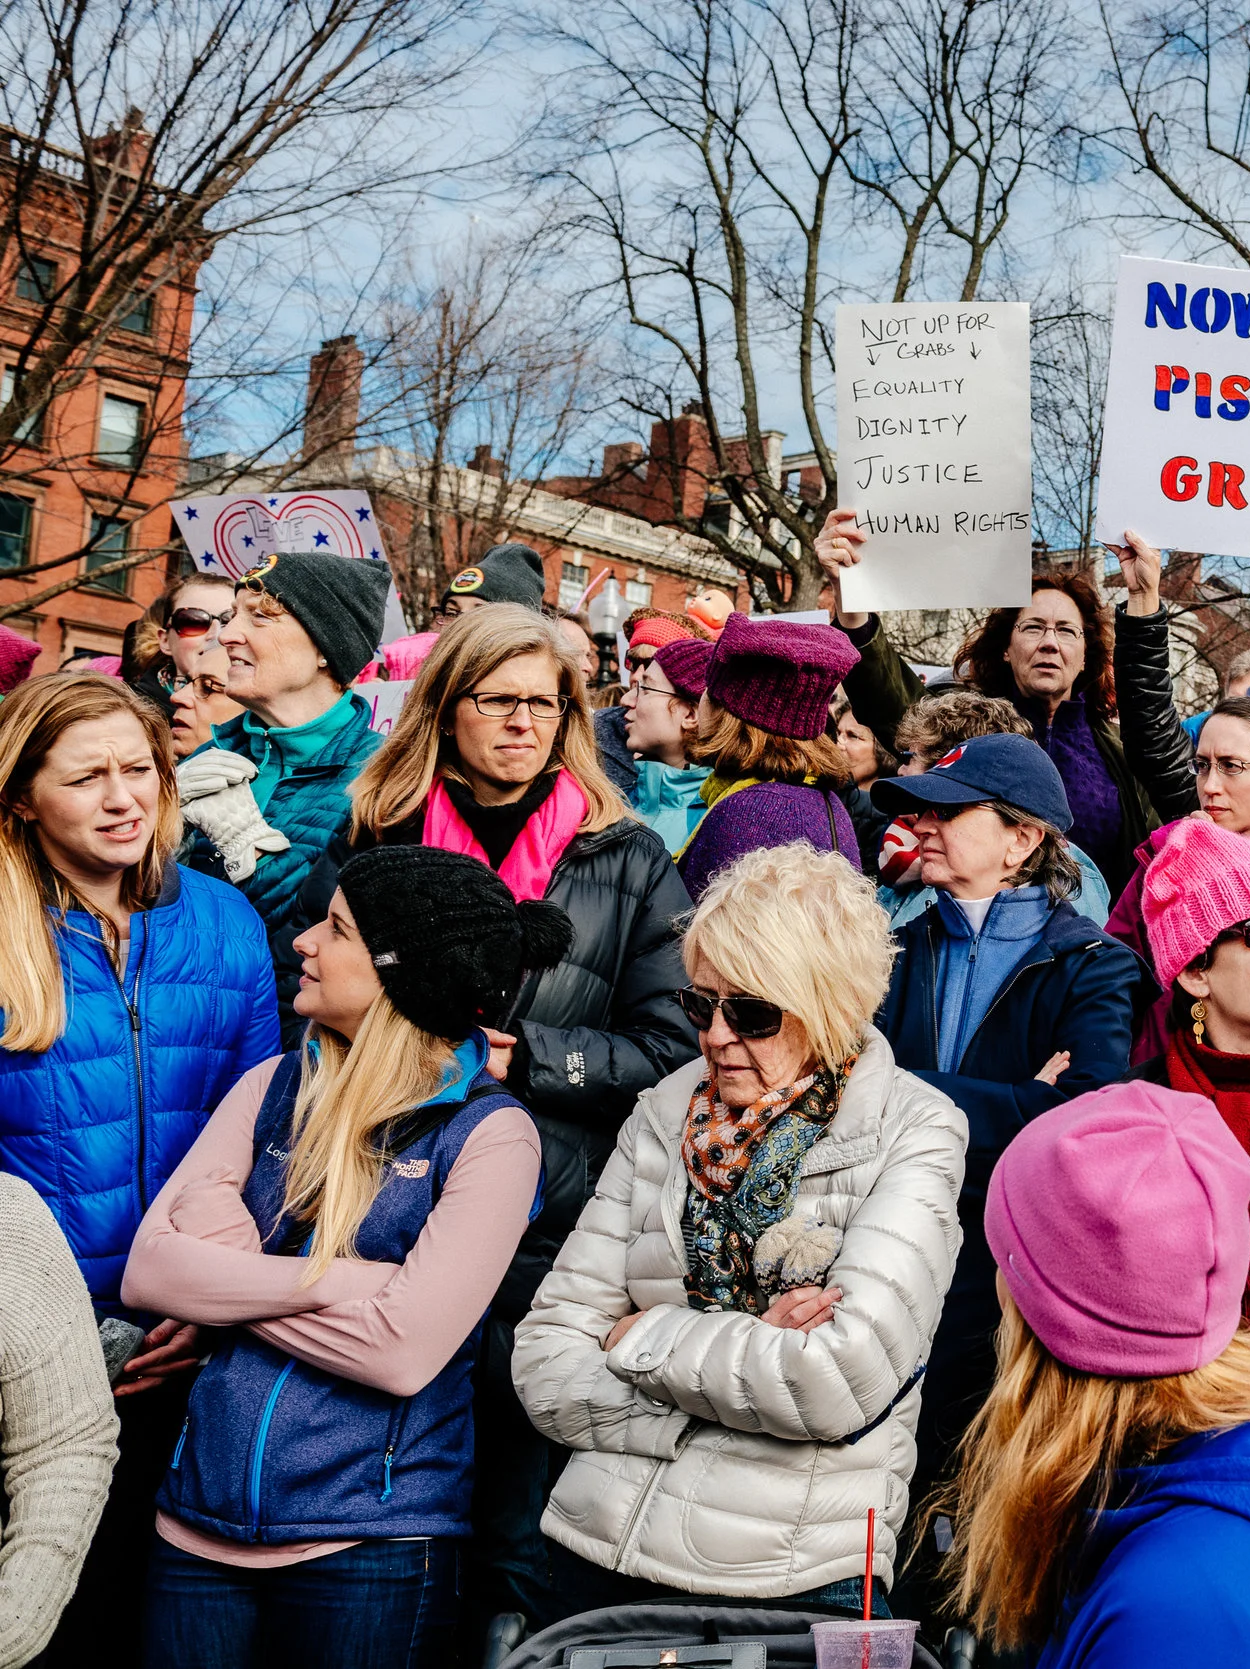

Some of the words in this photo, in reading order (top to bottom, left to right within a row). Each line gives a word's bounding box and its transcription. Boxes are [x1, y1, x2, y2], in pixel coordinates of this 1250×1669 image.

[861, 317, 917, 341] NOT
[924, 314, 950, 335] UP
[956, 312, 996, 333] FOR
[897, 342, 955, 359] GRABS
[853, 378, 965, 403] EQUALITY
[857, 414, 967, 440] DIGNITY
[854, 454, 983, 490] JUSTICE
[854, 509, 940, 535] HUMAN
[954, 510, 1030, 536] RIGHTS
[266, 1142, 288, 1162] Log
